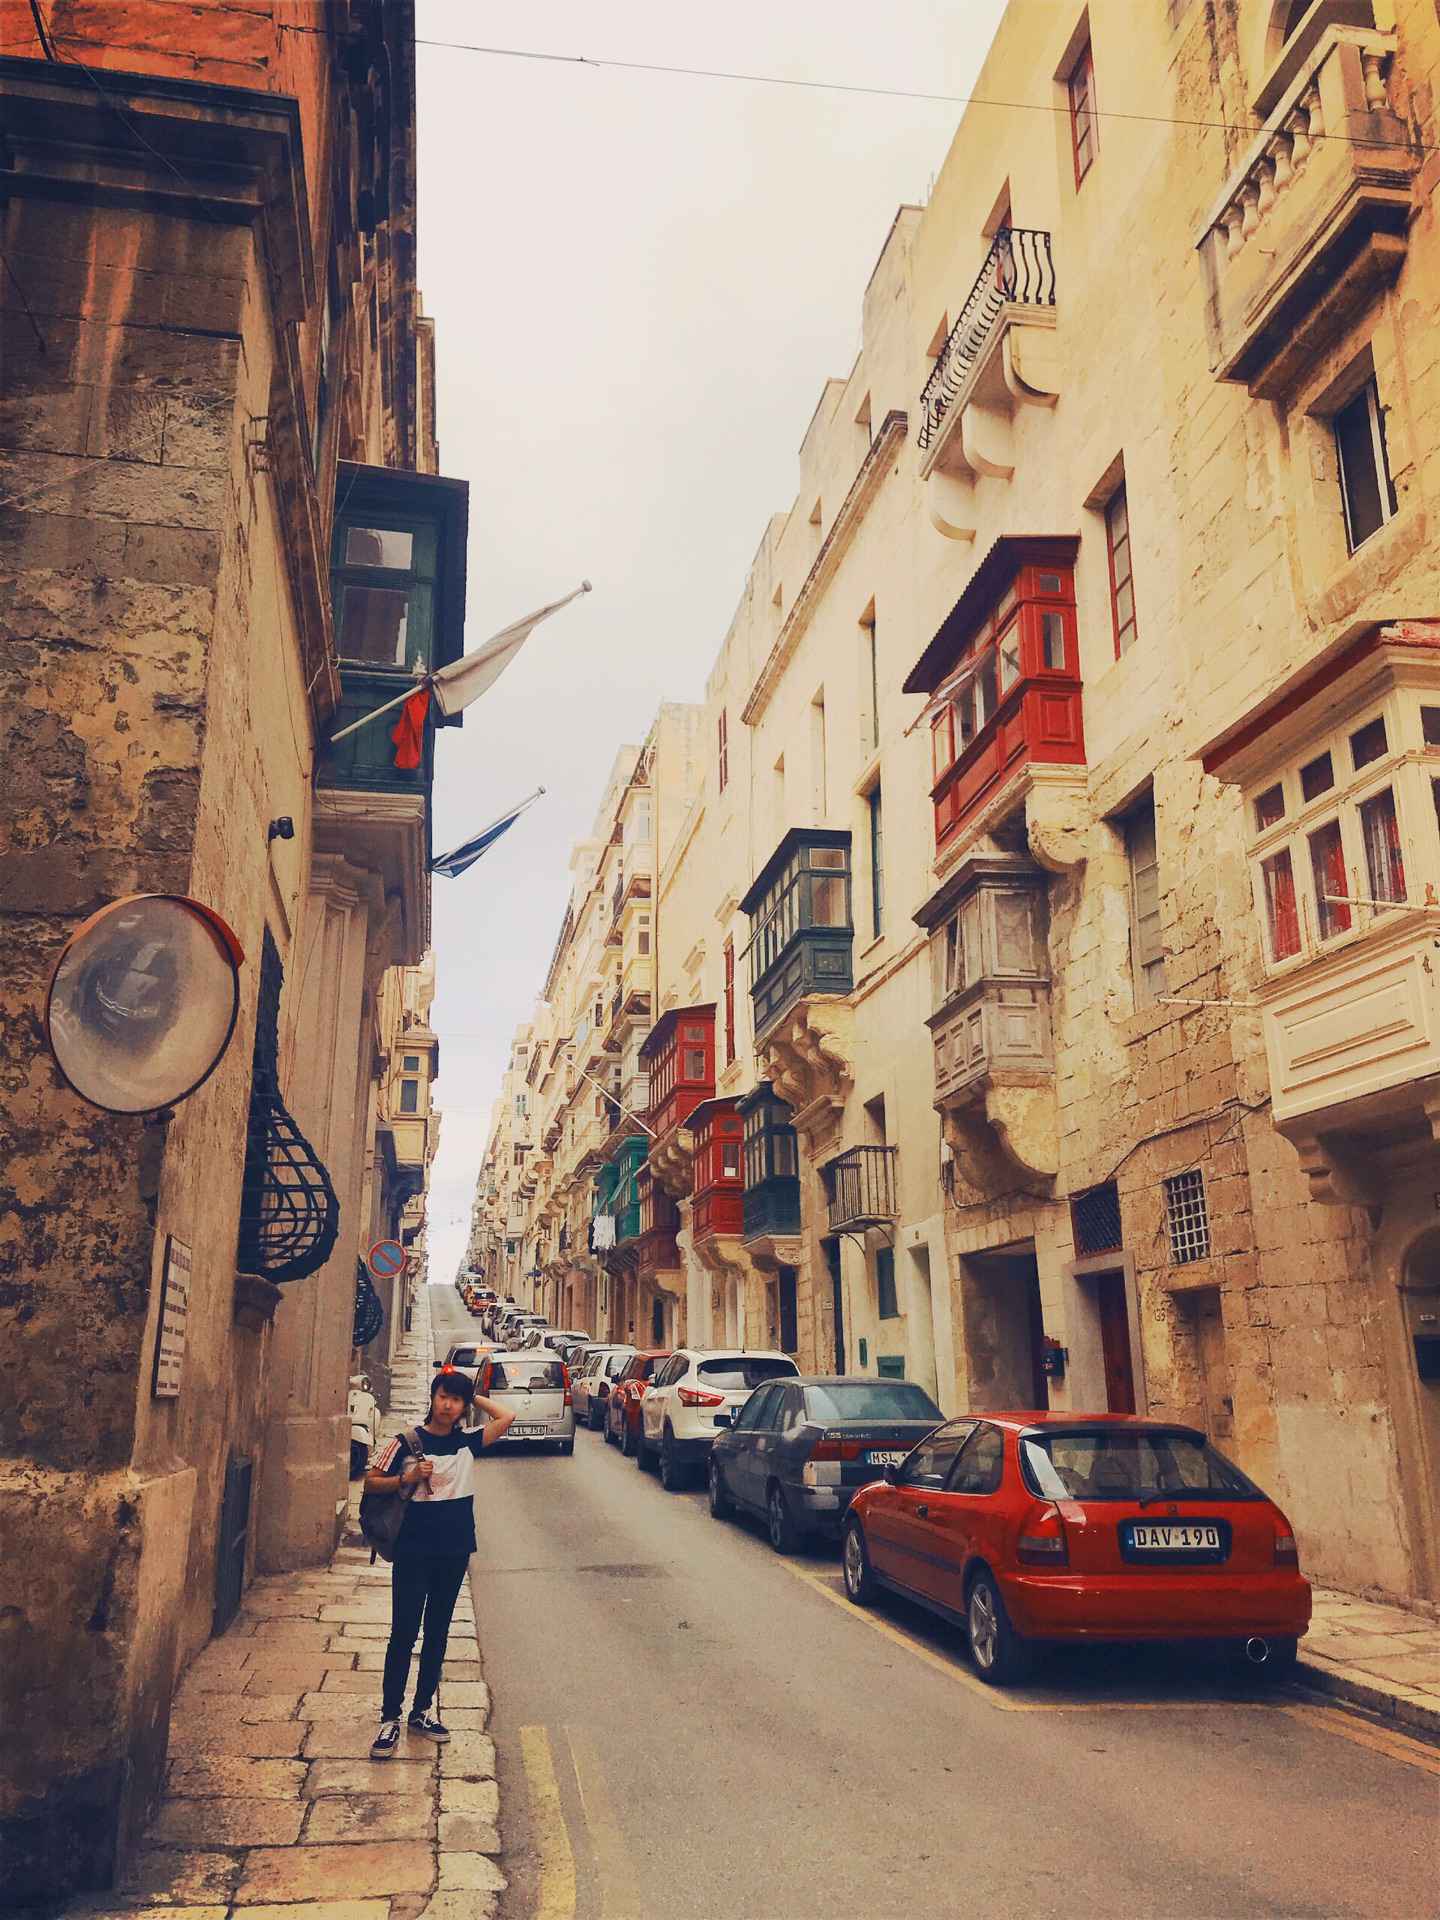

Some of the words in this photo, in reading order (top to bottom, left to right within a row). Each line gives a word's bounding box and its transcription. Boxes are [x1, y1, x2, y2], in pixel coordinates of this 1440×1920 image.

[872, 1452, 898, 1464] MSL
[1136, 1528, 1171, 1546] DAV
[1181, 1528, 1217, 1546] 190
